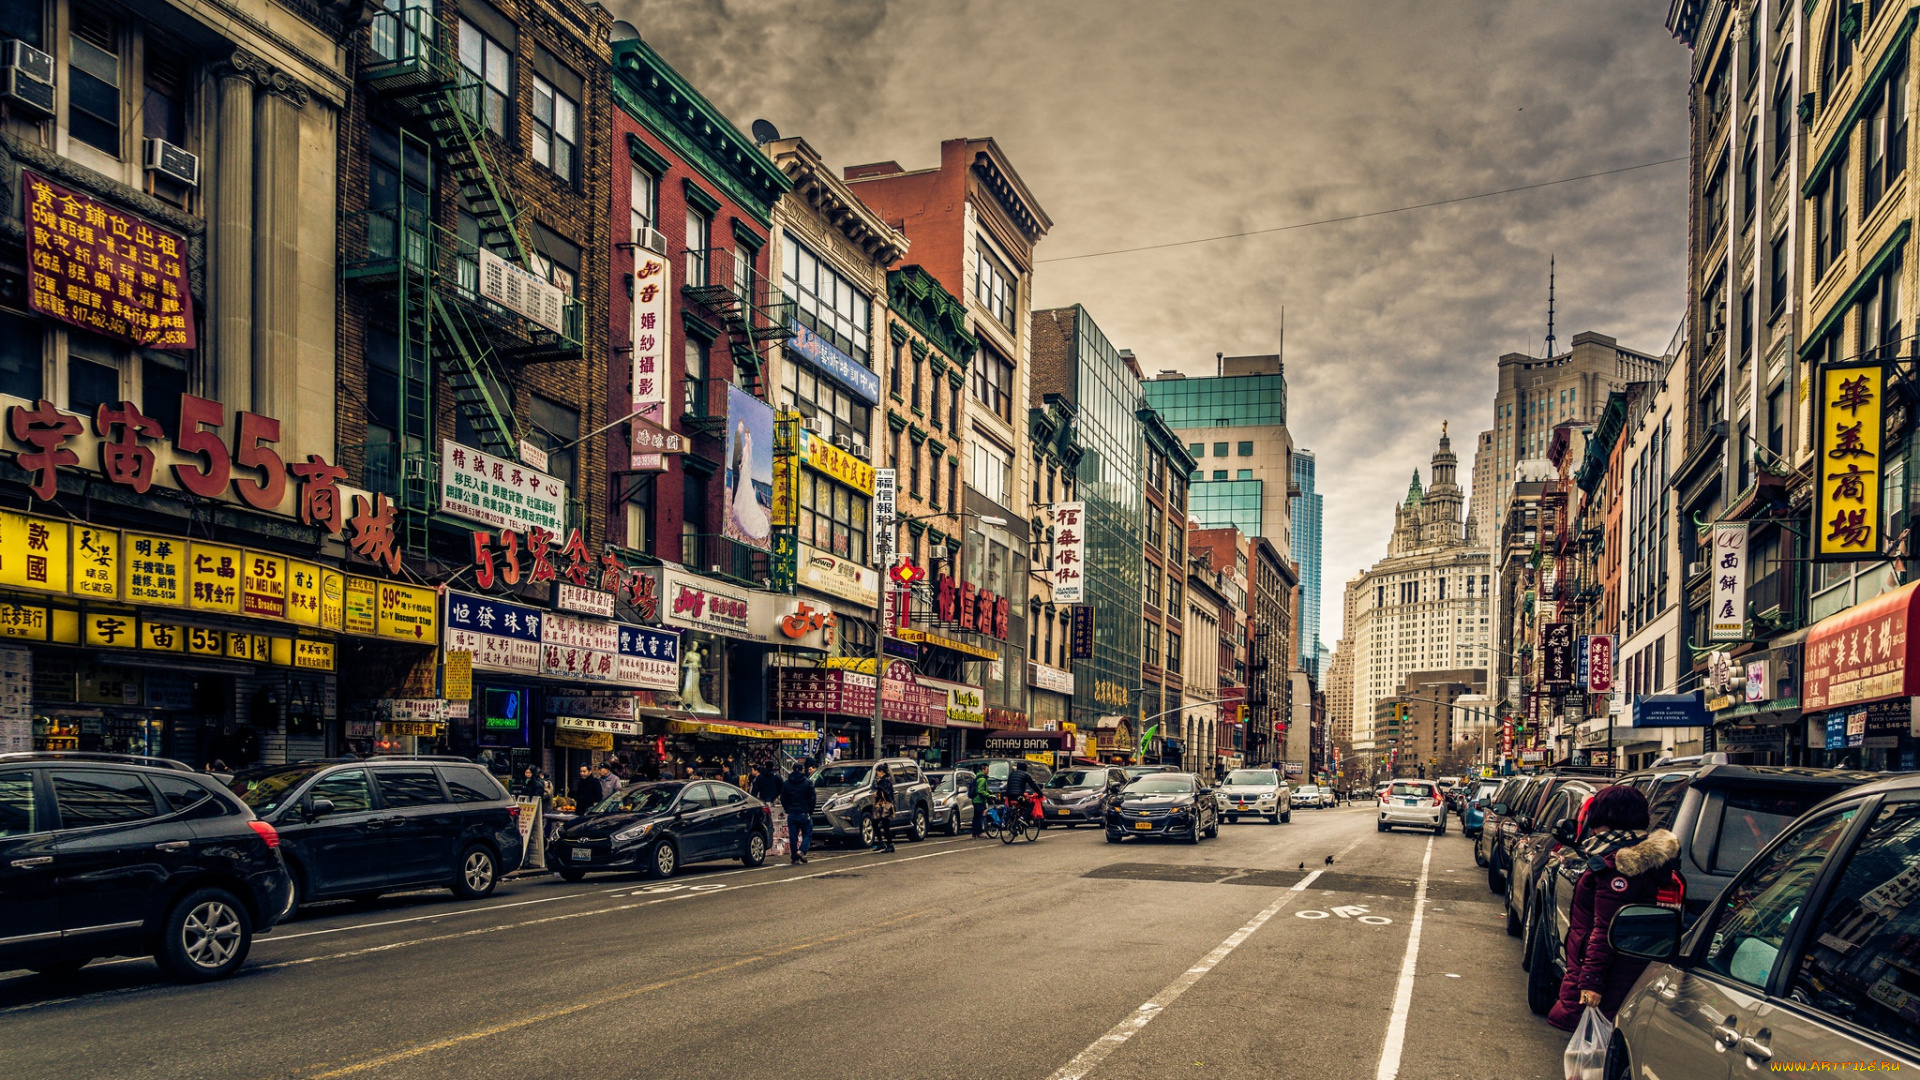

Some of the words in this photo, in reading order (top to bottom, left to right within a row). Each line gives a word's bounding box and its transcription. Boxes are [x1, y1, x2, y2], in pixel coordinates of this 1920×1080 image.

[31, 182, 179, 259] 黃金鋪位出租
[34, 226, 71, 256] 歡迎
[452, 447, 558, 498] 精誠服務中心
[810, 443, 875, 494] 中國社會民主黨
[1827, 374, 1876, 549] 華美商場
[454, 472, 489, 495] 移民入籍
[491, 484, 523, 506] 房屋貸款
[526, 495, 557, 516] 社區福利
[482, 497, 512, 516] 商業貸款
[514, 506, 562, 529] 免費政府醫療卡
[851, 503, 865, 524] 301
[135, 539, 173, 561] 明華
[1055, 508, 1082, 584] 福華傢俬
[1717, 530, 1744, 549] QQ
[131, 560, 176, 577] 手機電腦
[245, 575, 255, 591] FU
[255, 578, 269, 594] MEI
[253, 558, 277, 579] 55
[1719, 552, 1739, 619] 西餅屋
[453, 602, 540, 638] 恒發珠寶
[1834, 617, 1893, 672] 華美商場
[985, 738, 1022, 749] CATHAY
[1023, 738, 1049, 749] BANK
